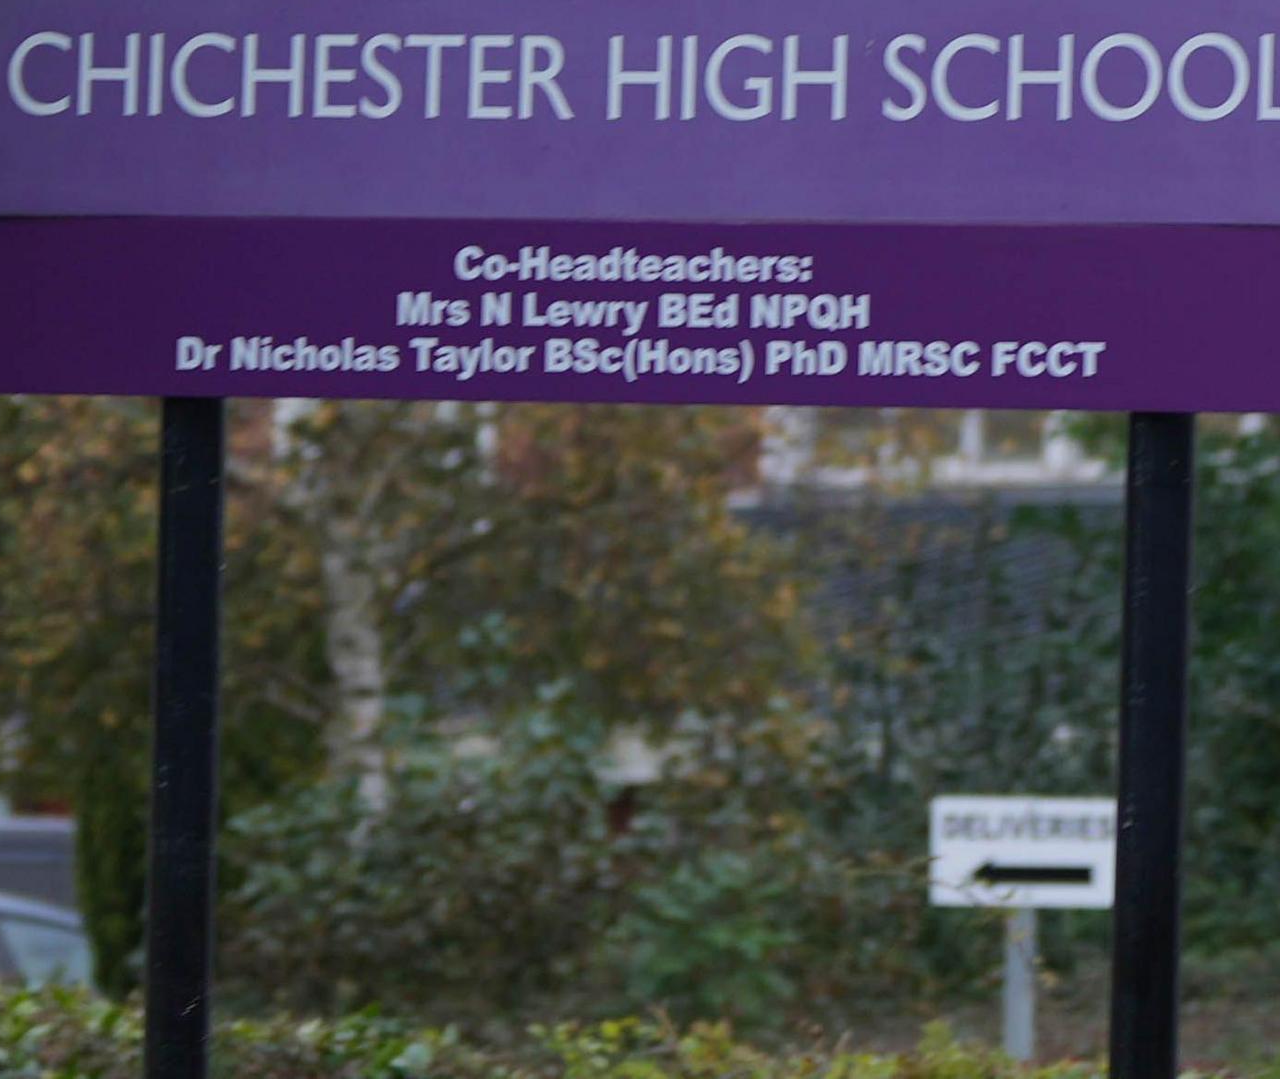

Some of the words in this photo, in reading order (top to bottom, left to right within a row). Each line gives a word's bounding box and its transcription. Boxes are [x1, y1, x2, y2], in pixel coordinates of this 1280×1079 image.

[9, 32, 575, 121] CHICHESTER
[607, 34, 849, 122] HIGH
[454, 245, 814, 283] Co-Headteachers:
[396, 291, 471, 326] Mrs
[481, 291, 512, 326] N
[522, 291, 649, 337] Lewry
[658, 292, 739, 328] BEd
[750, 293, 871, 331] NPQH
[176, 336, 222, 371] Dr
[230, 336, 400, 373] Nicholas
[409, 337, 536, 381] Taylor
[544, 338, 754, 383] BSc(Hons)
[765, 340, 847, 376] PhD
[857, 341, 981, 377] MRSC
[991, 341, 1107, 377] FCCT
